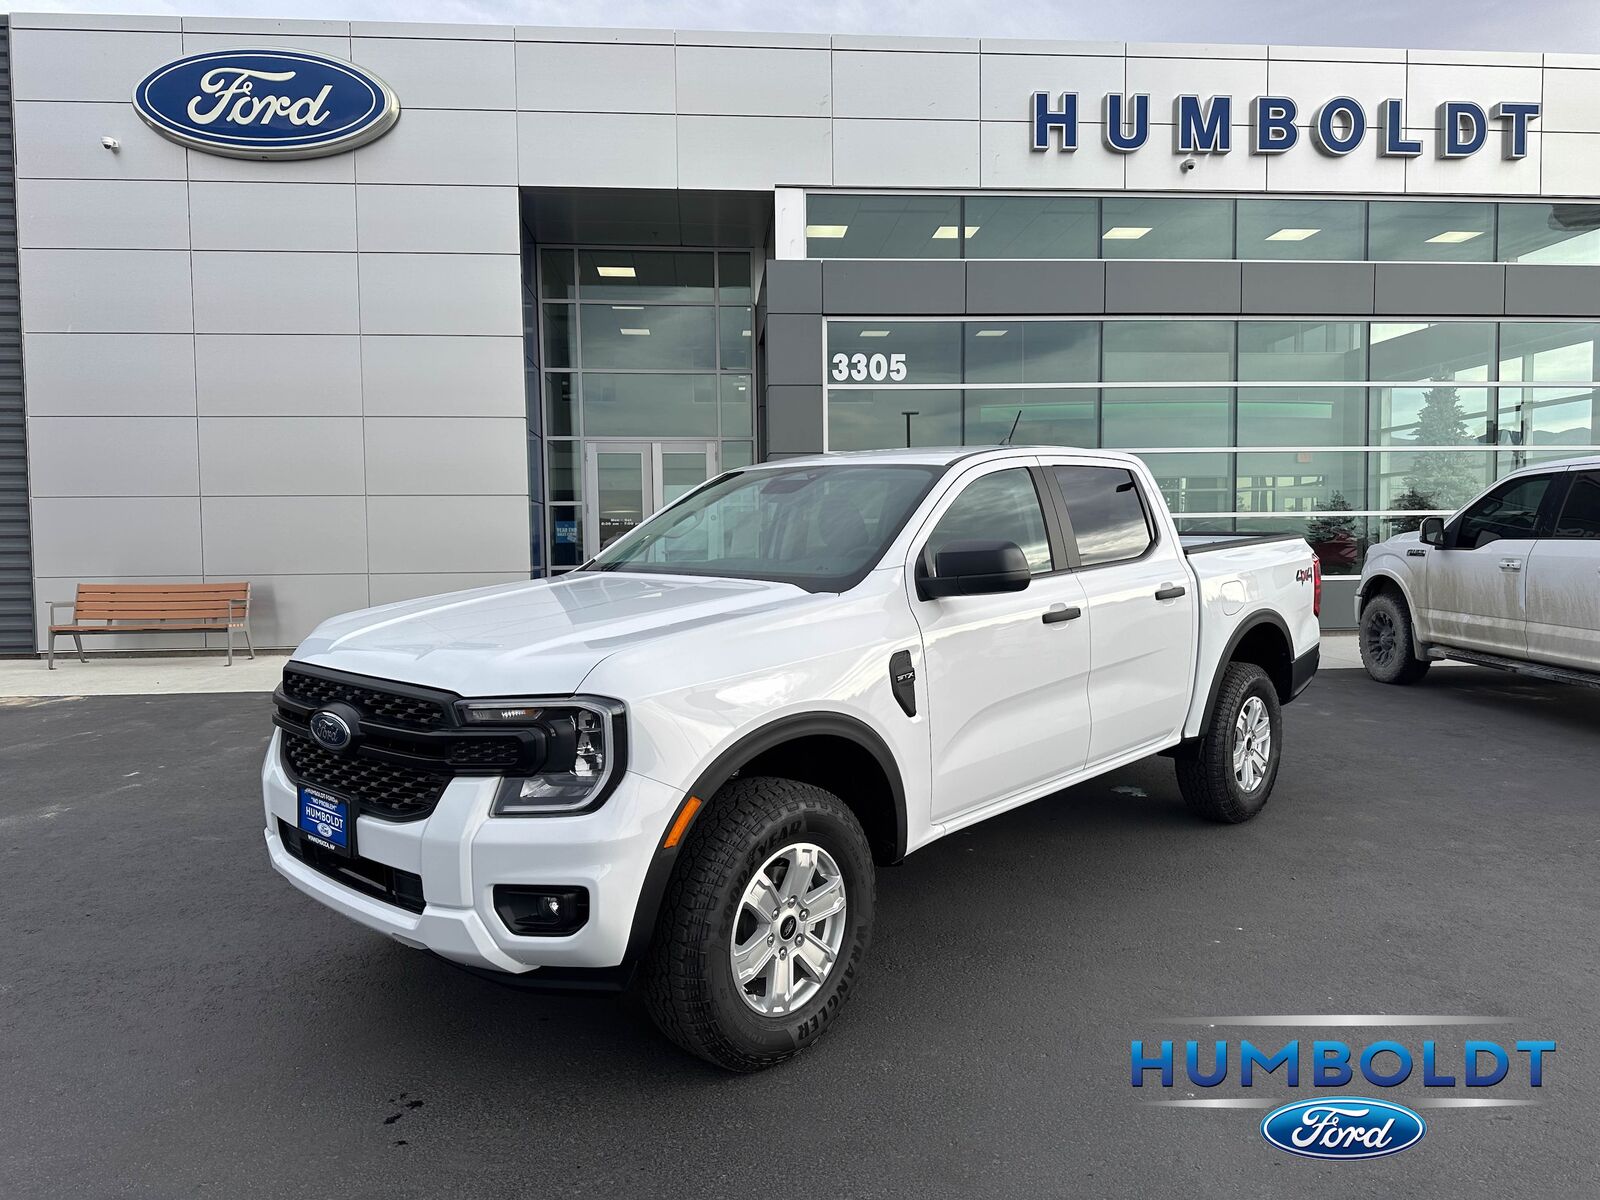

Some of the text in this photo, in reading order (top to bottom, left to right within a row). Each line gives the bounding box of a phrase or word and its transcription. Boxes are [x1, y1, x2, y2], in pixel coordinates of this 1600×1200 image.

[187, 67, 333, 126] Ford
[1031, 91, 1541, 160] HUMBOLDT
[832, 353, 907, 381] 3305
[896, 671, 914, 682] STX
[316, 718, 339, 742] Ford
[305, 806, 343, 829] HUMBOLDT
[797, 924, 868, 1042] WRANGLER
